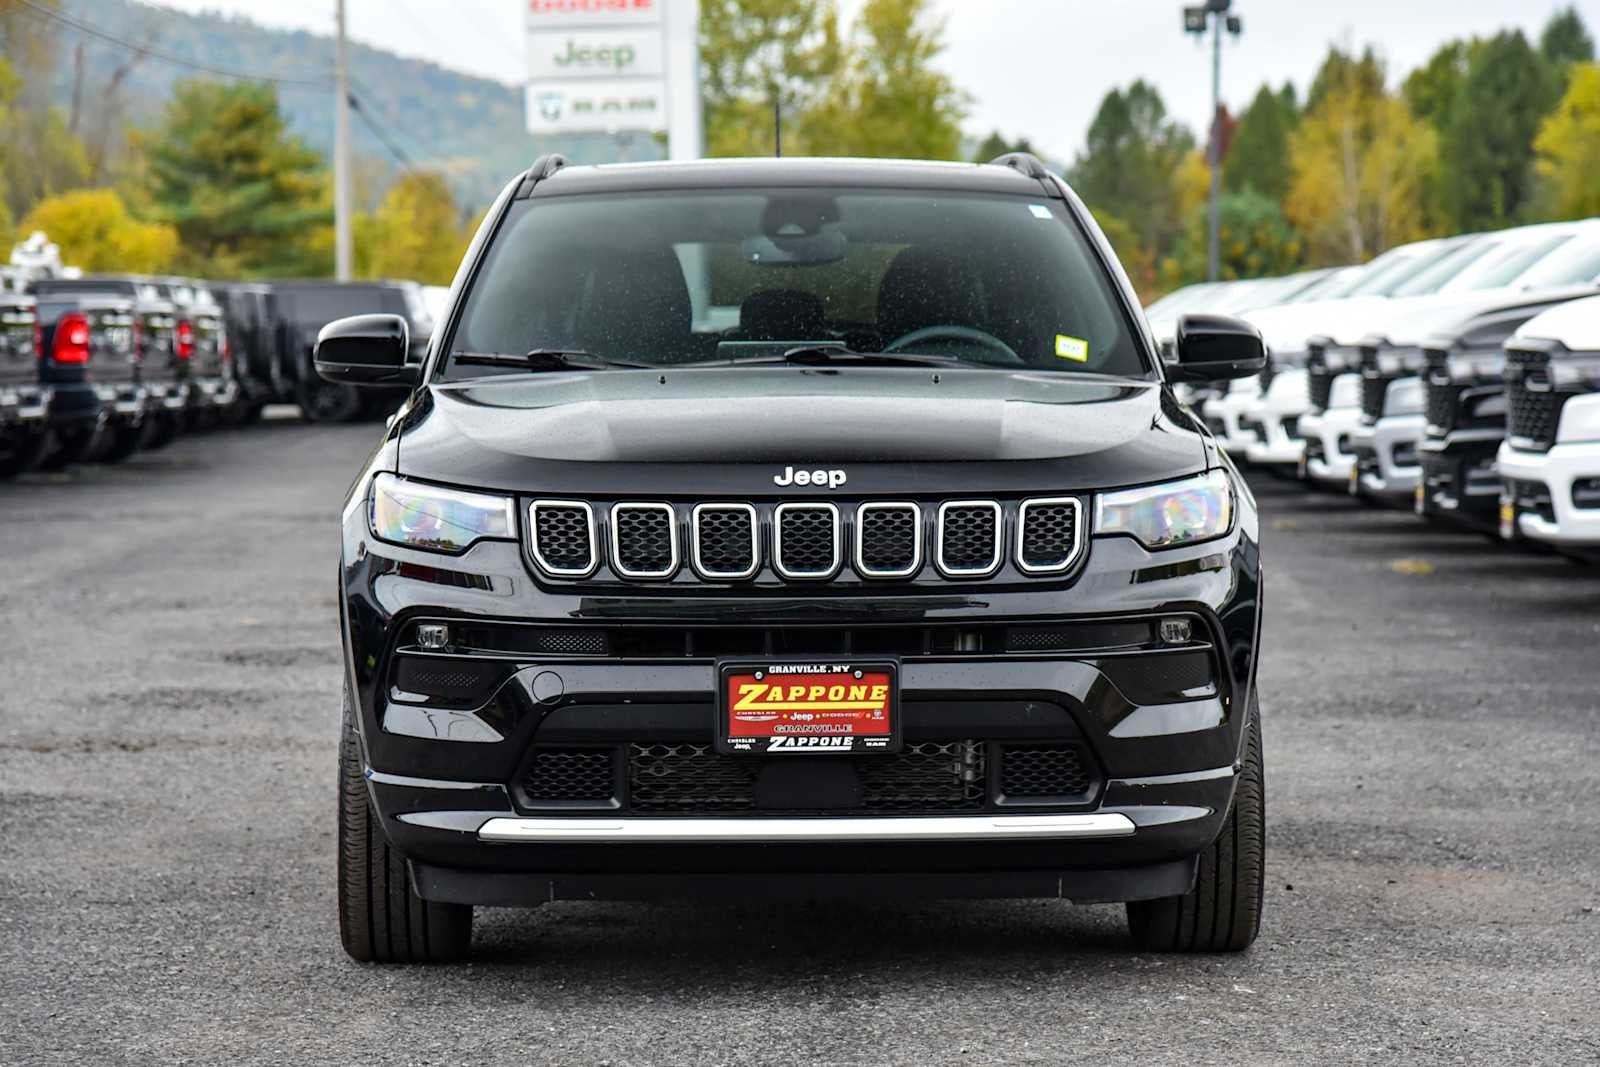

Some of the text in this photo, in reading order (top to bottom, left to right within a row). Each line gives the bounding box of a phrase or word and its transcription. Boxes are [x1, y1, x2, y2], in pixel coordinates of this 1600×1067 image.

[553, 40, 635, 70] Jeep
[774, 466, 847, 489] Jeep
[832, 665, 850, 673] NY
[733, 684, 889, 710] ZAPPONE
[790, 712, 814, 721] Jeep
[774, 724, 853, 733] GRANVILLE
[766, 736, 854, 752] ZAPPONE
